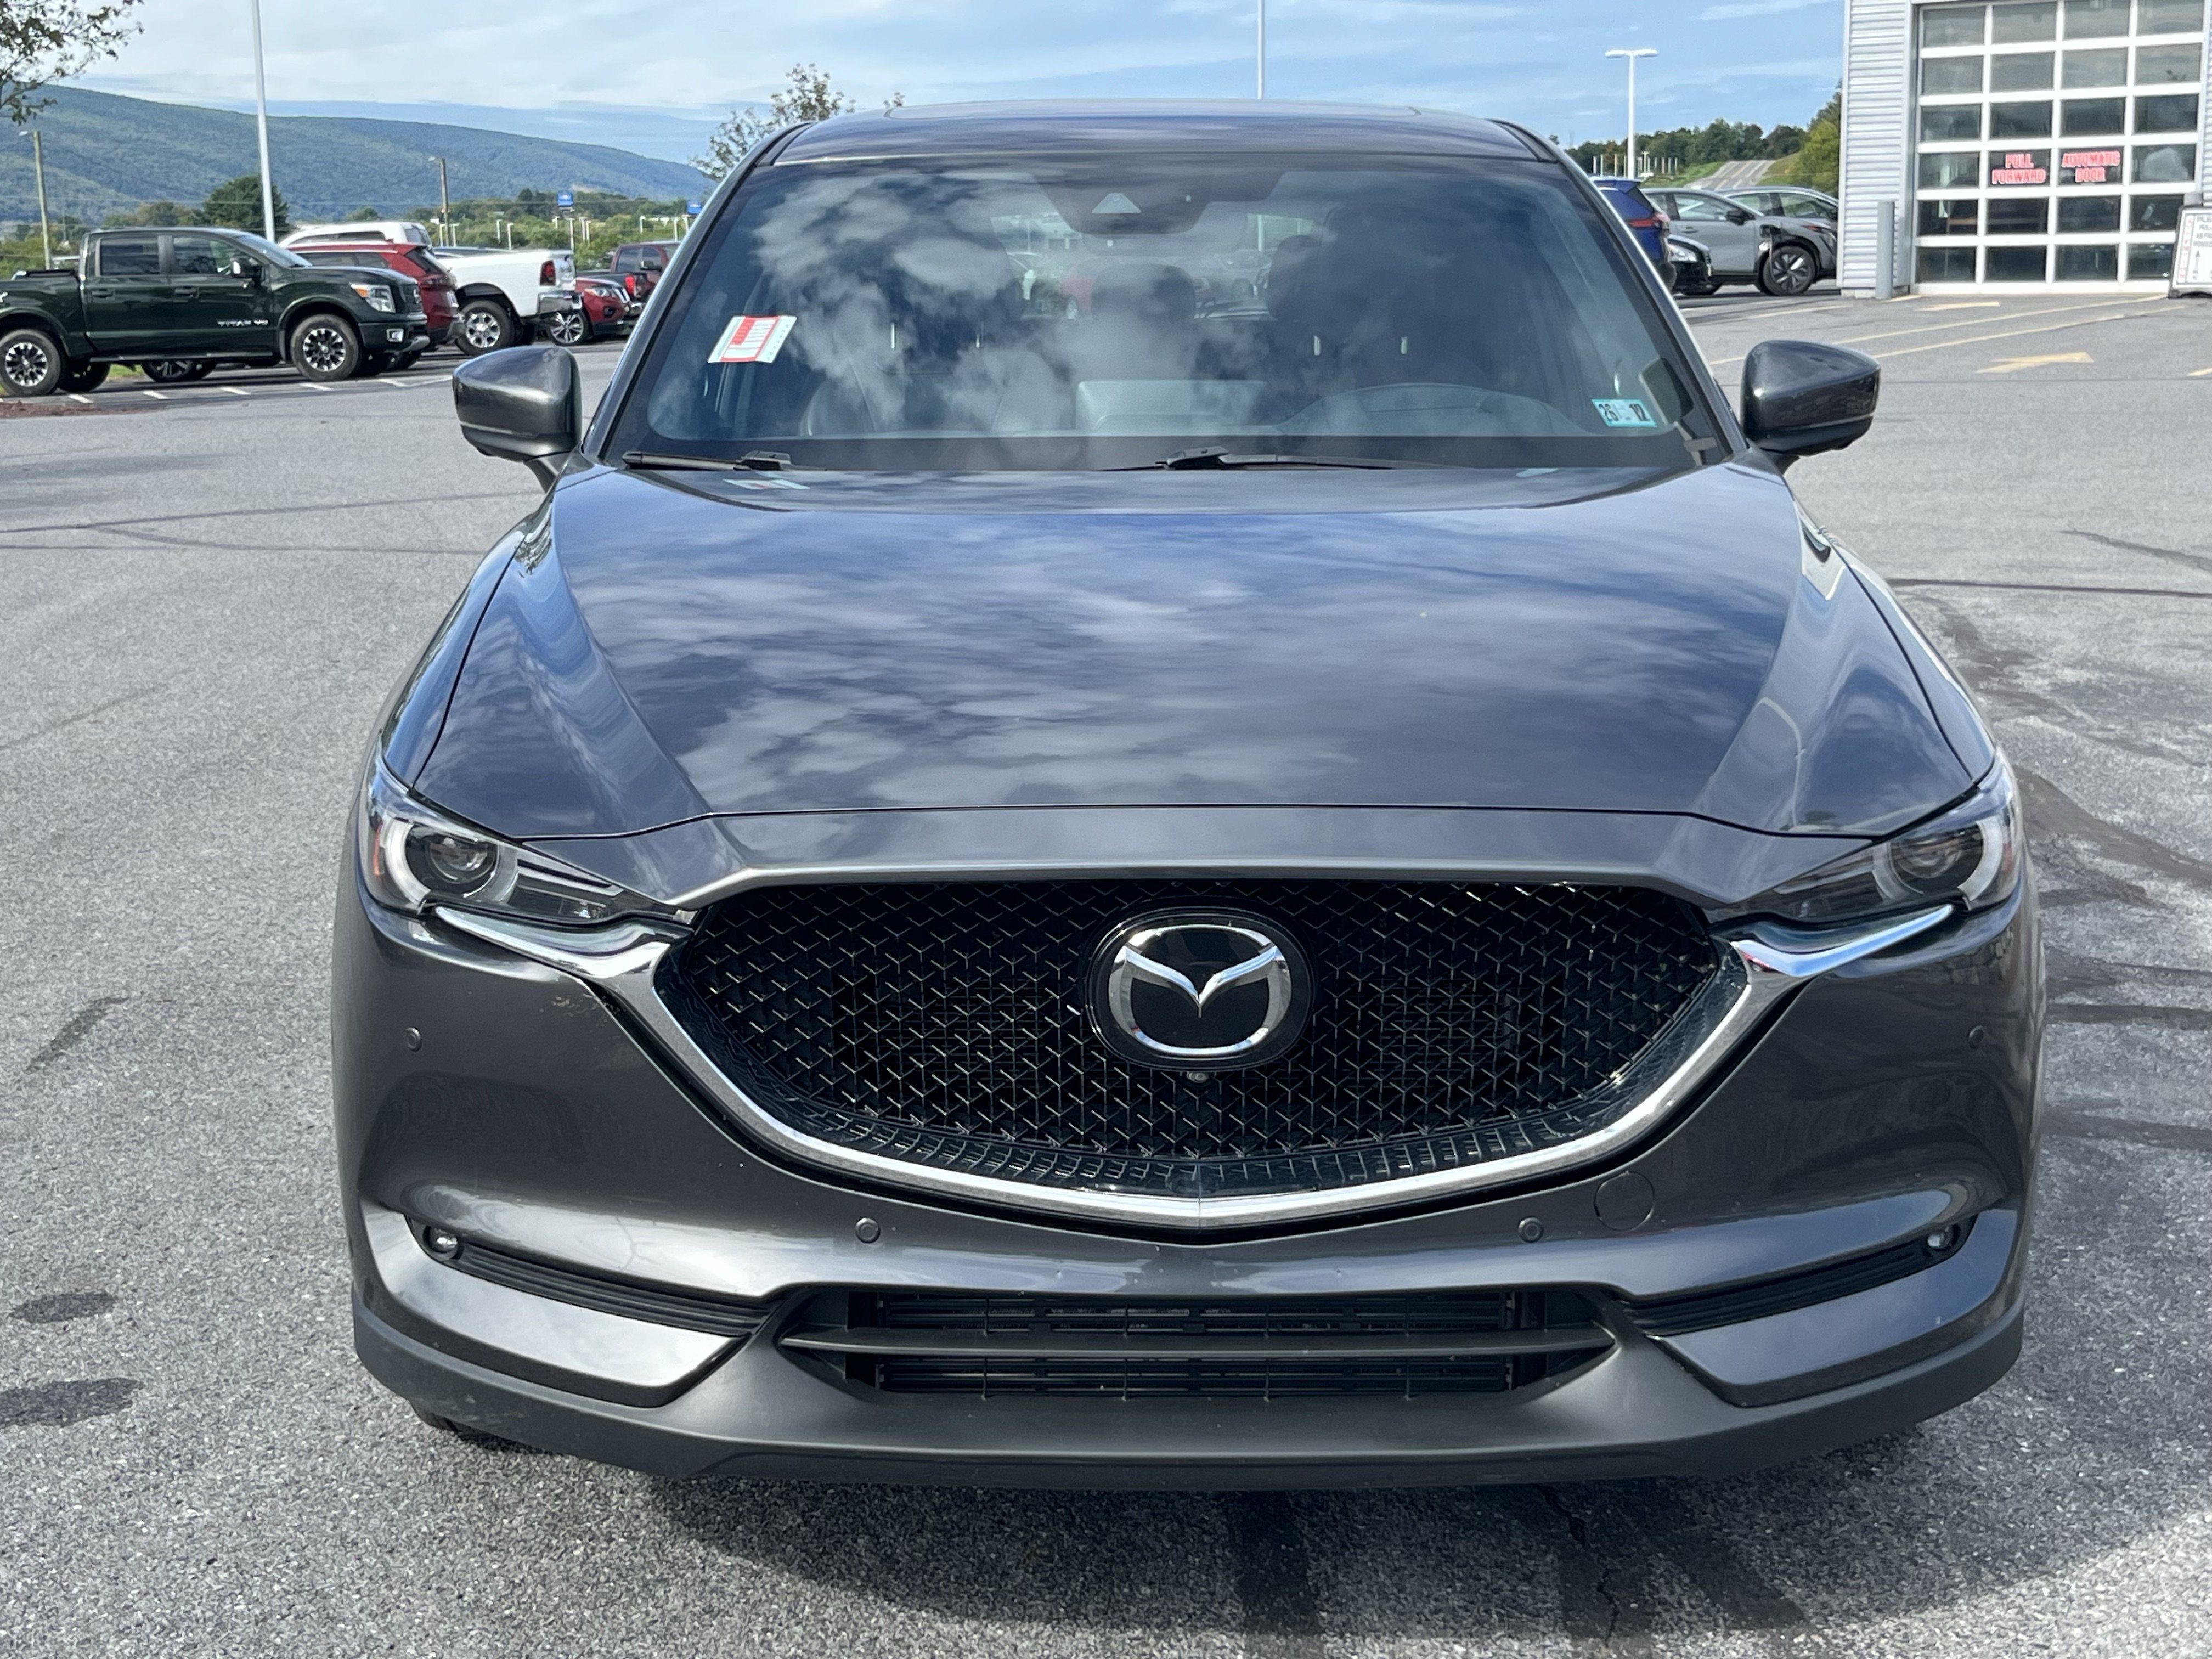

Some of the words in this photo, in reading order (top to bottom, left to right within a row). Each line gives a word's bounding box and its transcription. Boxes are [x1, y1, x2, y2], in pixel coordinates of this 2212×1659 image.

[2006, 153, 2034, 168] PULL
[2062, 151, 2120, 168] AUTOMATIC
[1992, 168, 2046, 184] FORWARD
[2075, 167, 2106, 183] DOOR
[1629, 403, 1650, 421] 12
